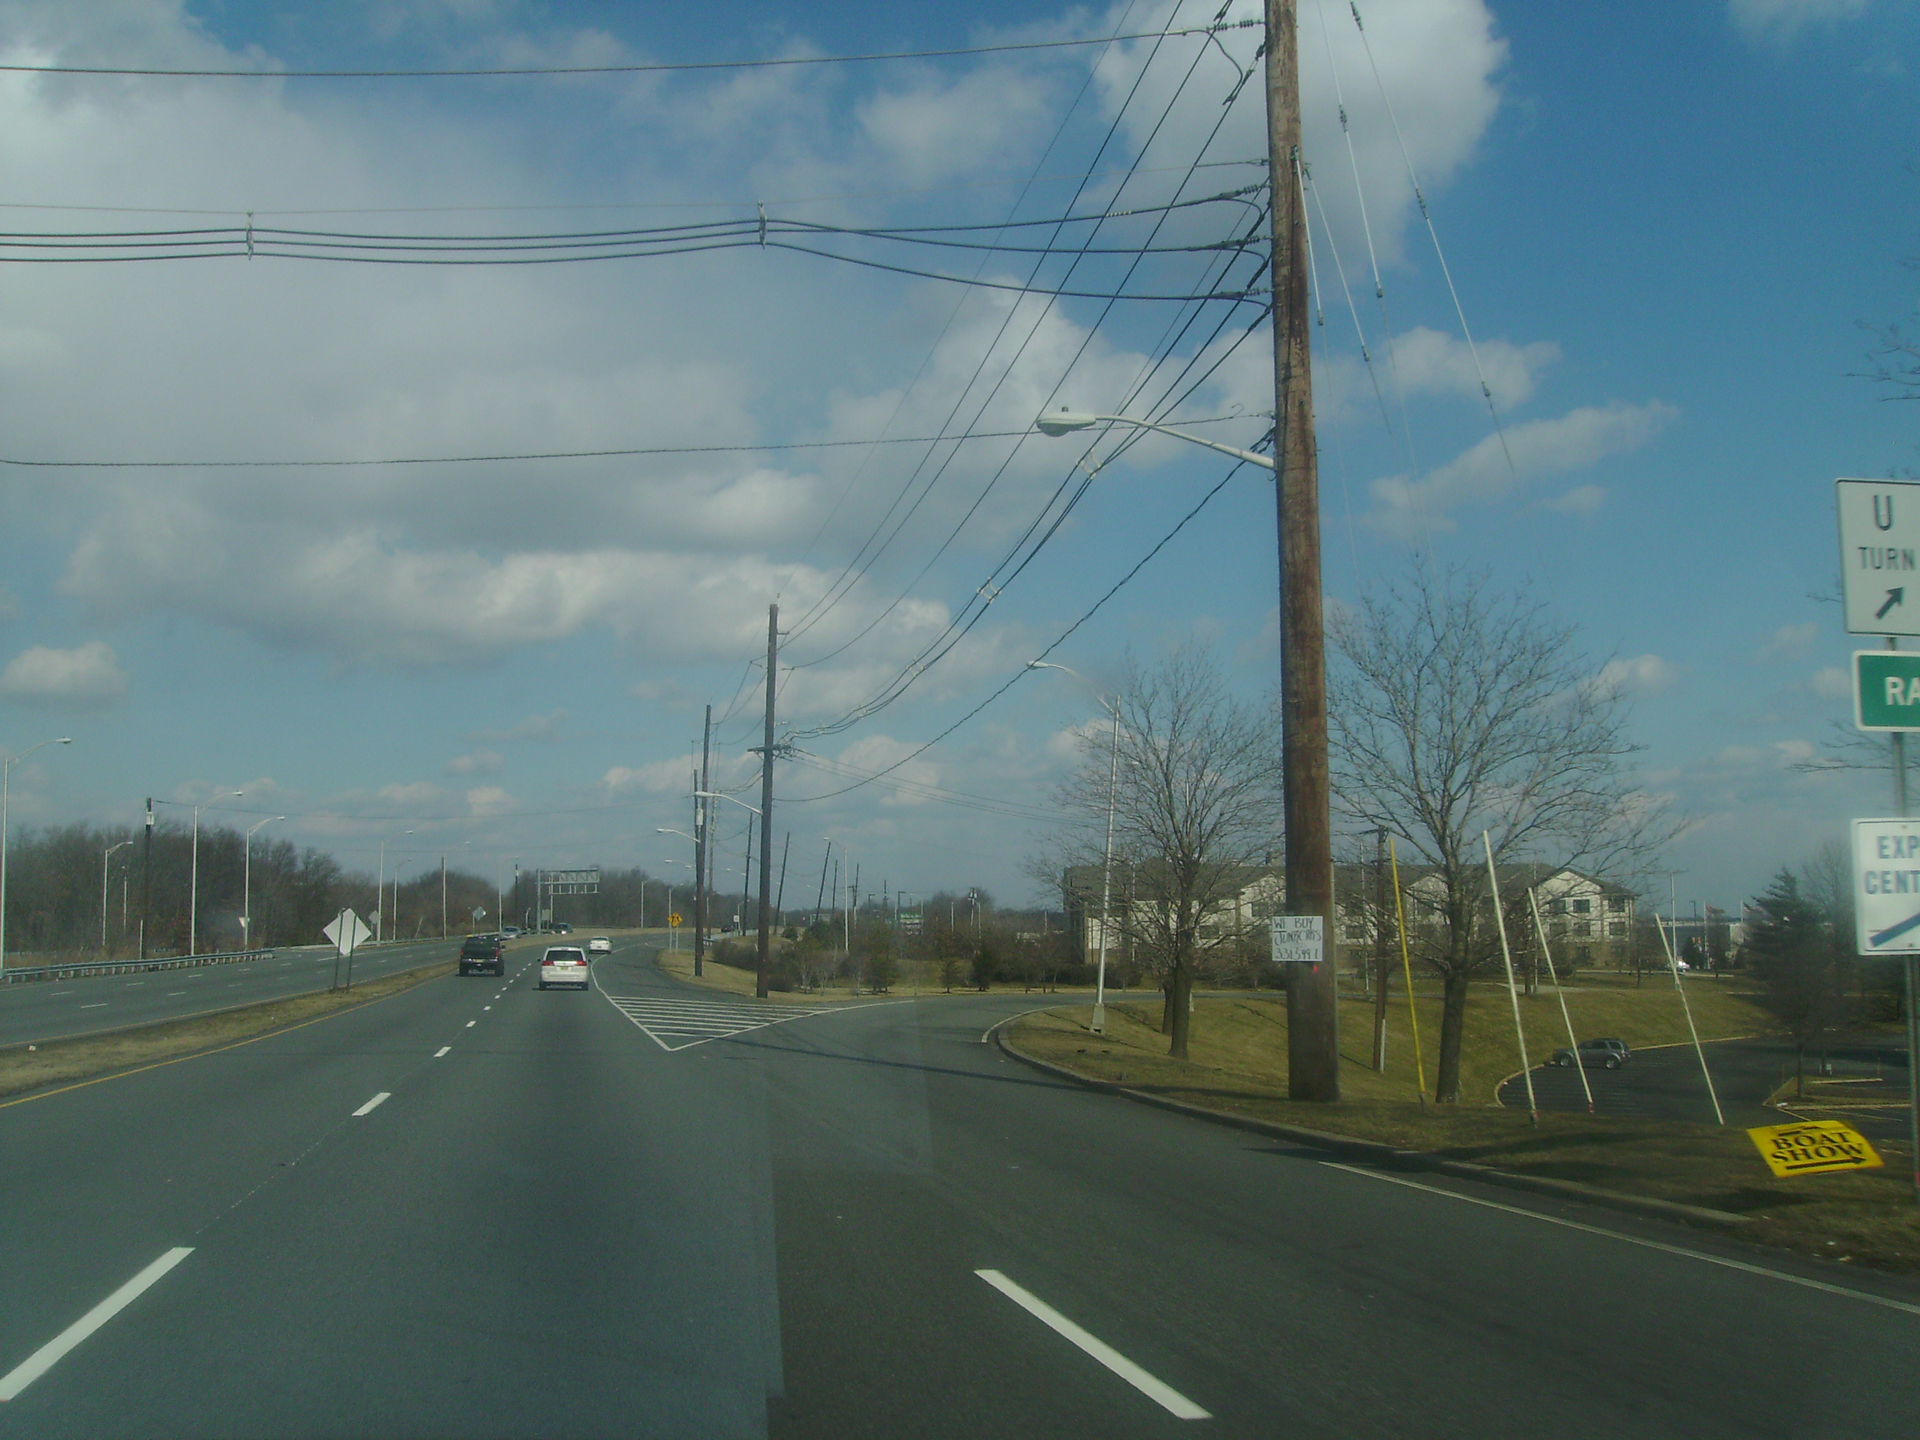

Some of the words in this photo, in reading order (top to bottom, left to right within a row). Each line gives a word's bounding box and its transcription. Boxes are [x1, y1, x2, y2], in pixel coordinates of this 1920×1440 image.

[1873, 495, 1893, 531] U
[1858, 546, 1916, 570] TURN
[1294, 917, 1314, 930] BUY
[1770, 1131, 1850, 1150] BOAT
[1771, 1143, 1863, 1164] SHOW
